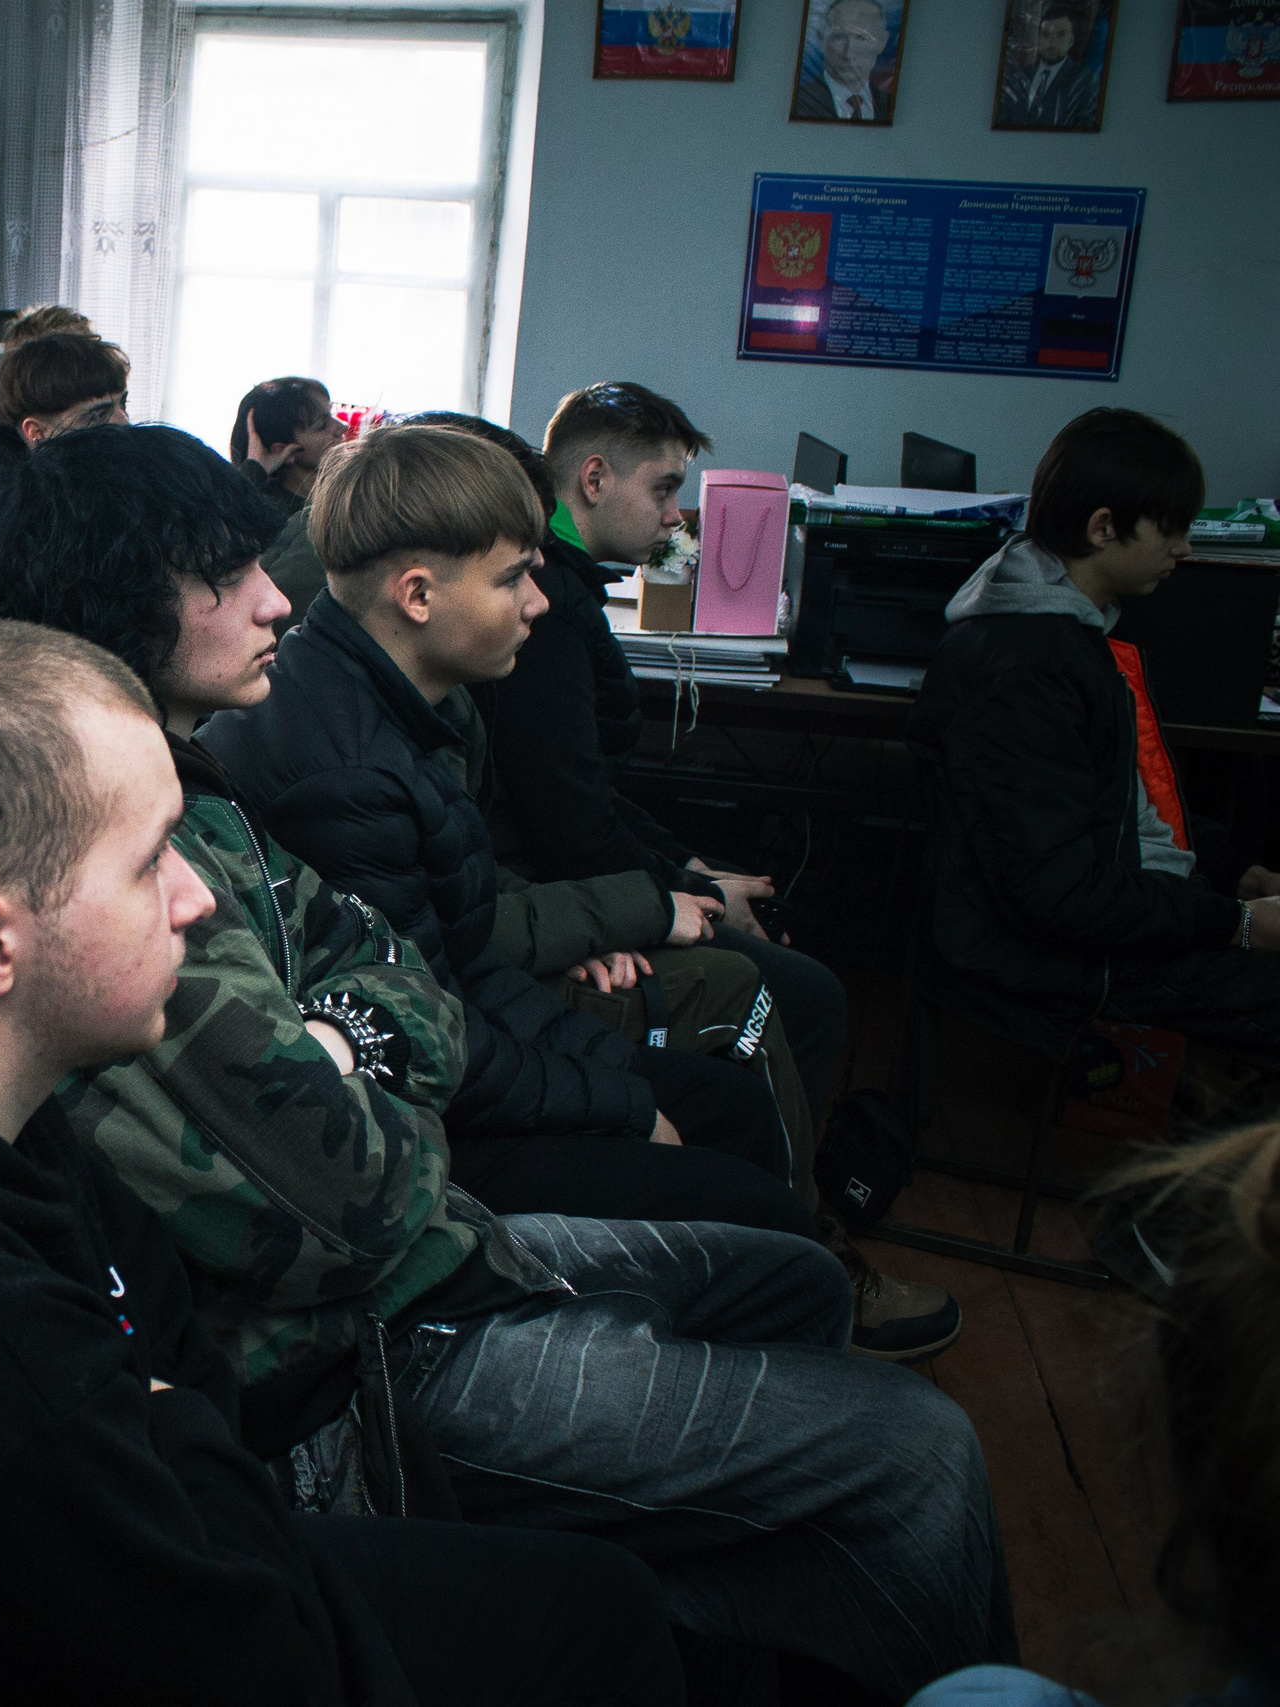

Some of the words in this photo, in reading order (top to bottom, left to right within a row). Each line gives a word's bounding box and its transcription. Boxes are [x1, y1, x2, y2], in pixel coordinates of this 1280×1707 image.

[823, 183, 878, 195] Символика
[792, 192, 850, 202] Российской
[851, 194, 908, 206] Федерации
[1013, 192, 1070, 203] Символика
[958, 200, 1009, 211] Донецкой
[1011, 201, 1060, 213] Народной
[1063, 204, 1123, 215] Республики
[824, 541, 848, 549] Canon
